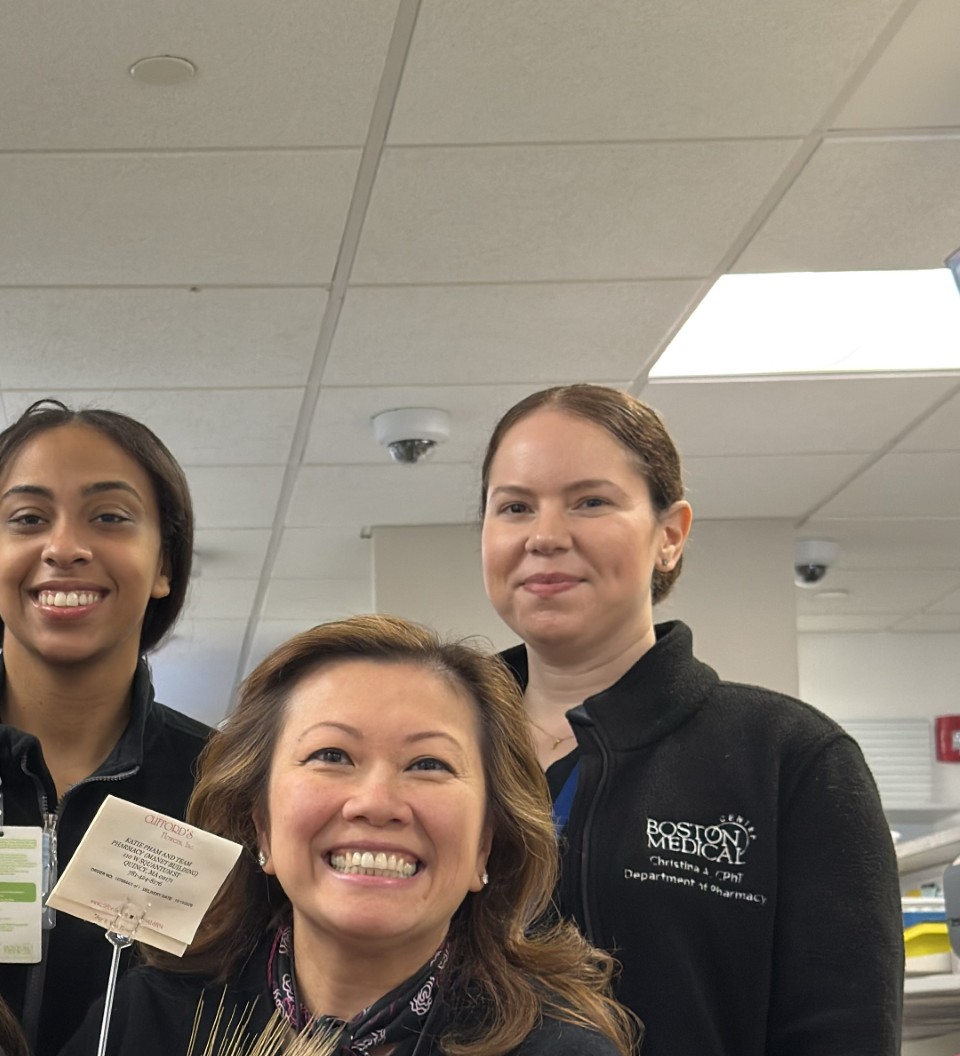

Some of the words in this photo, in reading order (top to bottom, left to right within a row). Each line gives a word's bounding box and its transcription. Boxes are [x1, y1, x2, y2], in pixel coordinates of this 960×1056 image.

[144, 814, 193, 840] CLIFFORD'S
[646, 817, 740, 847] BOSTON
[111, 839, 144, 857] PHARMACY
[144, 852, 168, 866] (MANET
[168, 861, 199, 877] BUILDING)
[125, 837, 144, 848] KATIE
[144, 844, 162, 855] PHAM
[162, 851, 176, 861] AND
[176, 856, 193, 867] TEAM
[647, 834, 746, 865] MEDICAL
[649, 855, 700, 874] Christina
[140, 858, 173, 876] SQUANTUM
[172, 870, 182, 878] ST
[148, 870, 159, 878] MA
[624, 868, 696, 887] Department
[710, 883, 768, 905] Pharmacy
